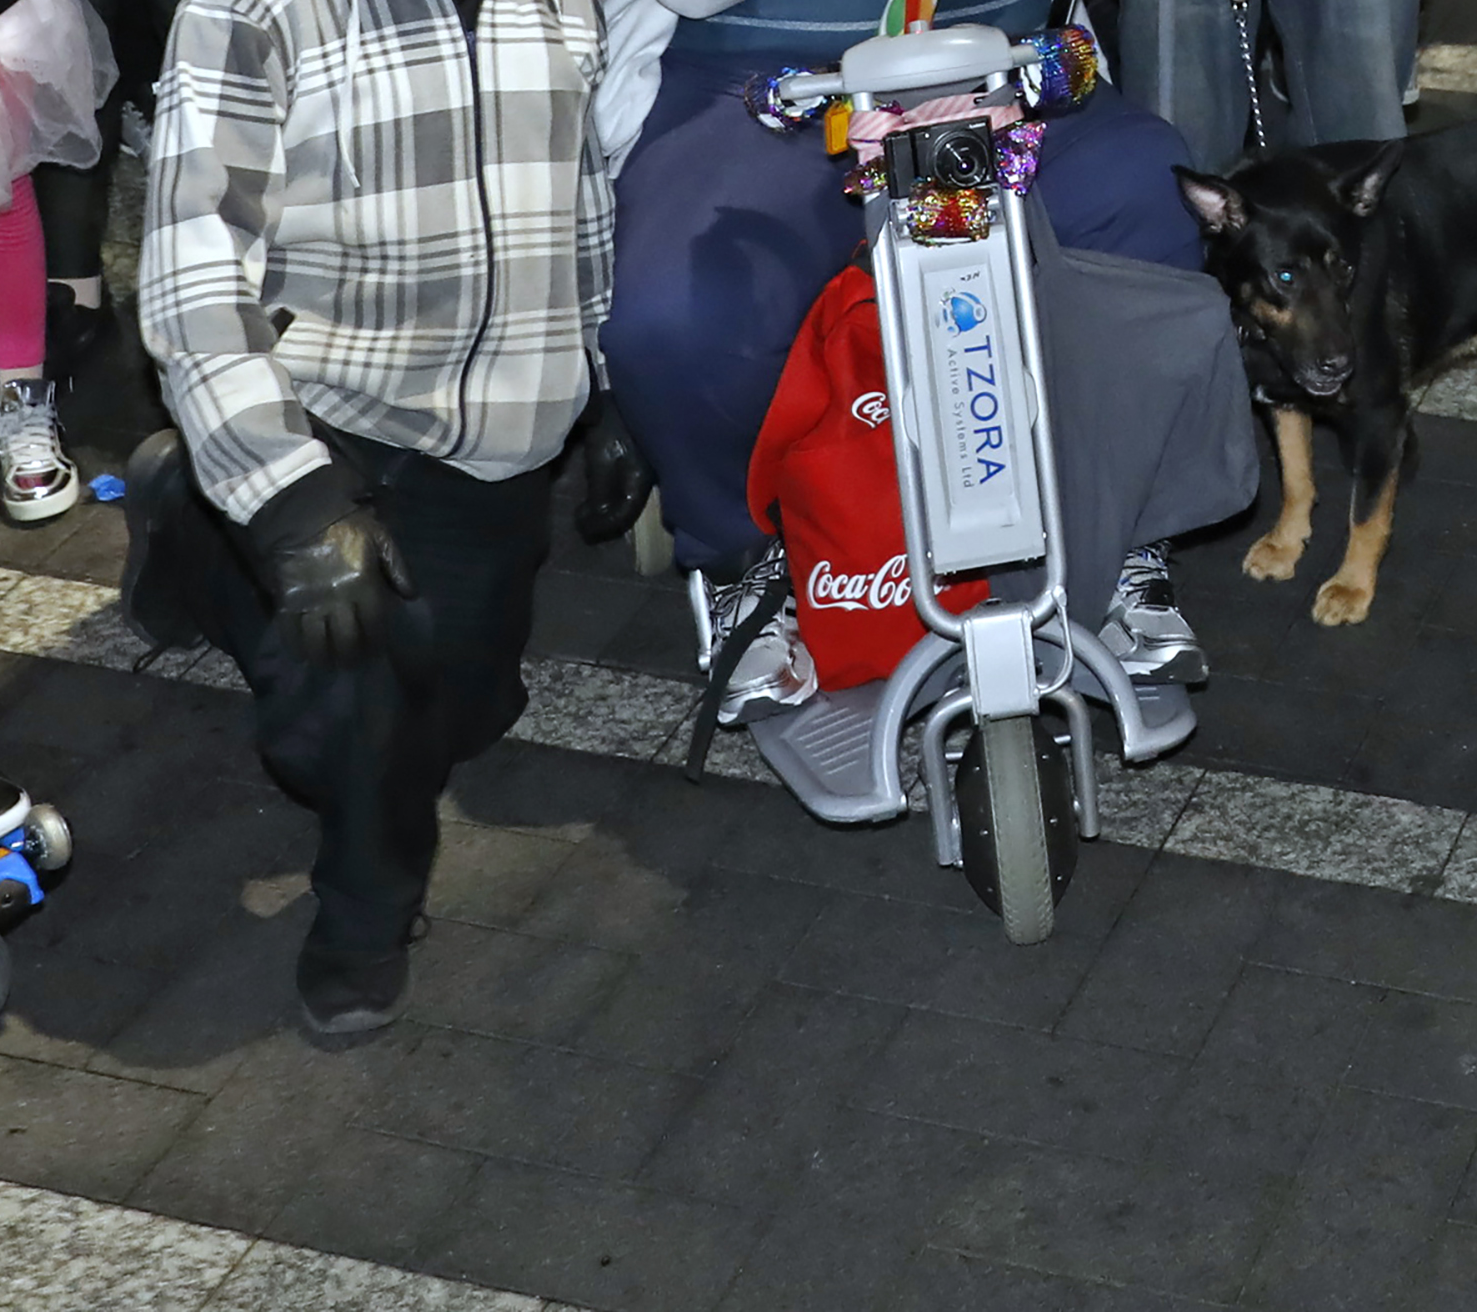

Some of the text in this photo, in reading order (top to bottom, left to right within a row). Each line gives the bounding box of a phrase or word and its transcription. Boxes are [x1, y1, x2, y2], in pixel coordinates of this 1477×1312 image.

[946, 347, 976, 490] Active Systems Ltd
[964, 334, 1007, 486] TZORA
[807, 554, 944, 612] Coca-Co
